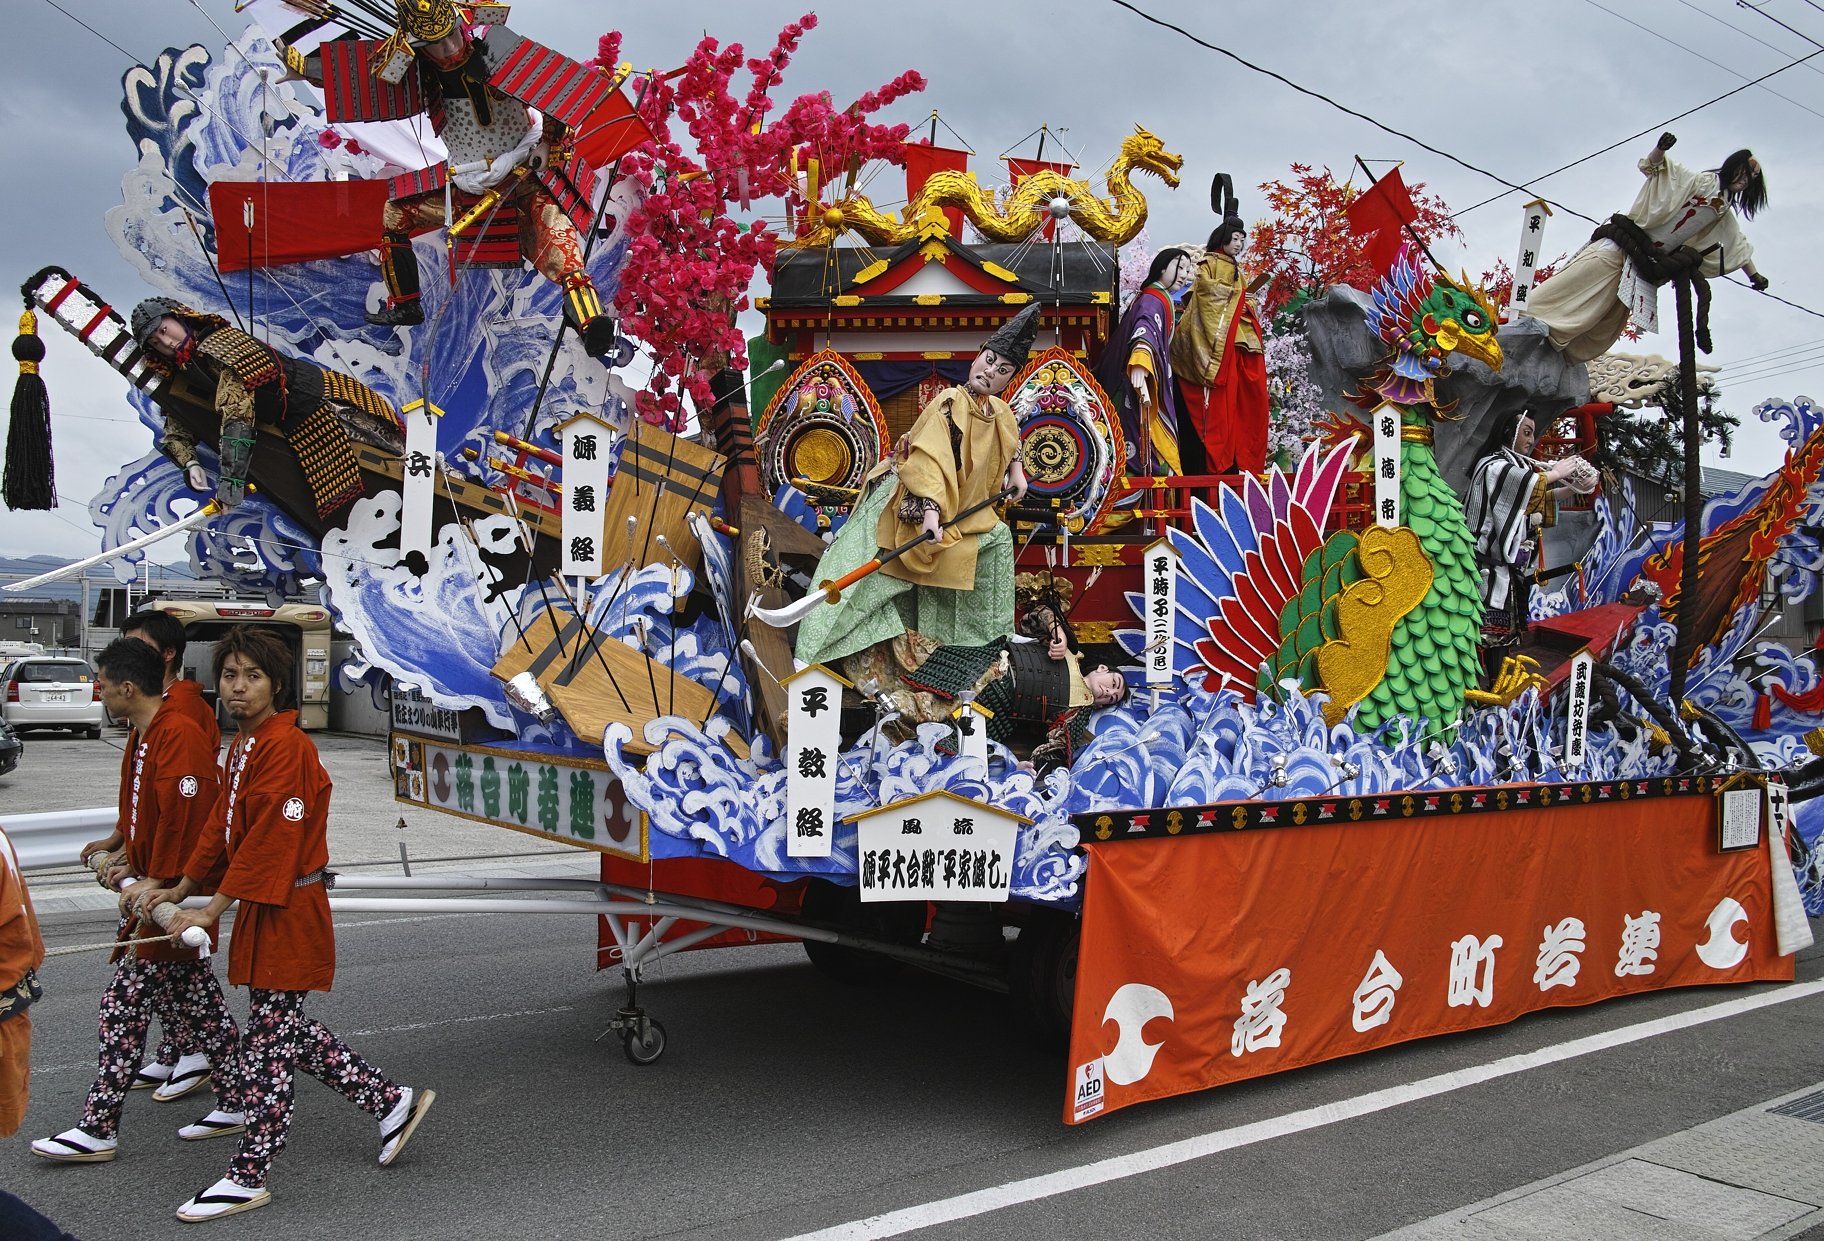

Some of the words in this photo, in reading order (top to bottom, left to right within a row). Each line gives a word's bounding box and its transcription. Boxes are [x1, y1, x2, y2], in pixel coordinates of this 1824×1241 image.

[570, 434, 598, 562] 源義経
[1077, 1078, 1101, 1101] AED
